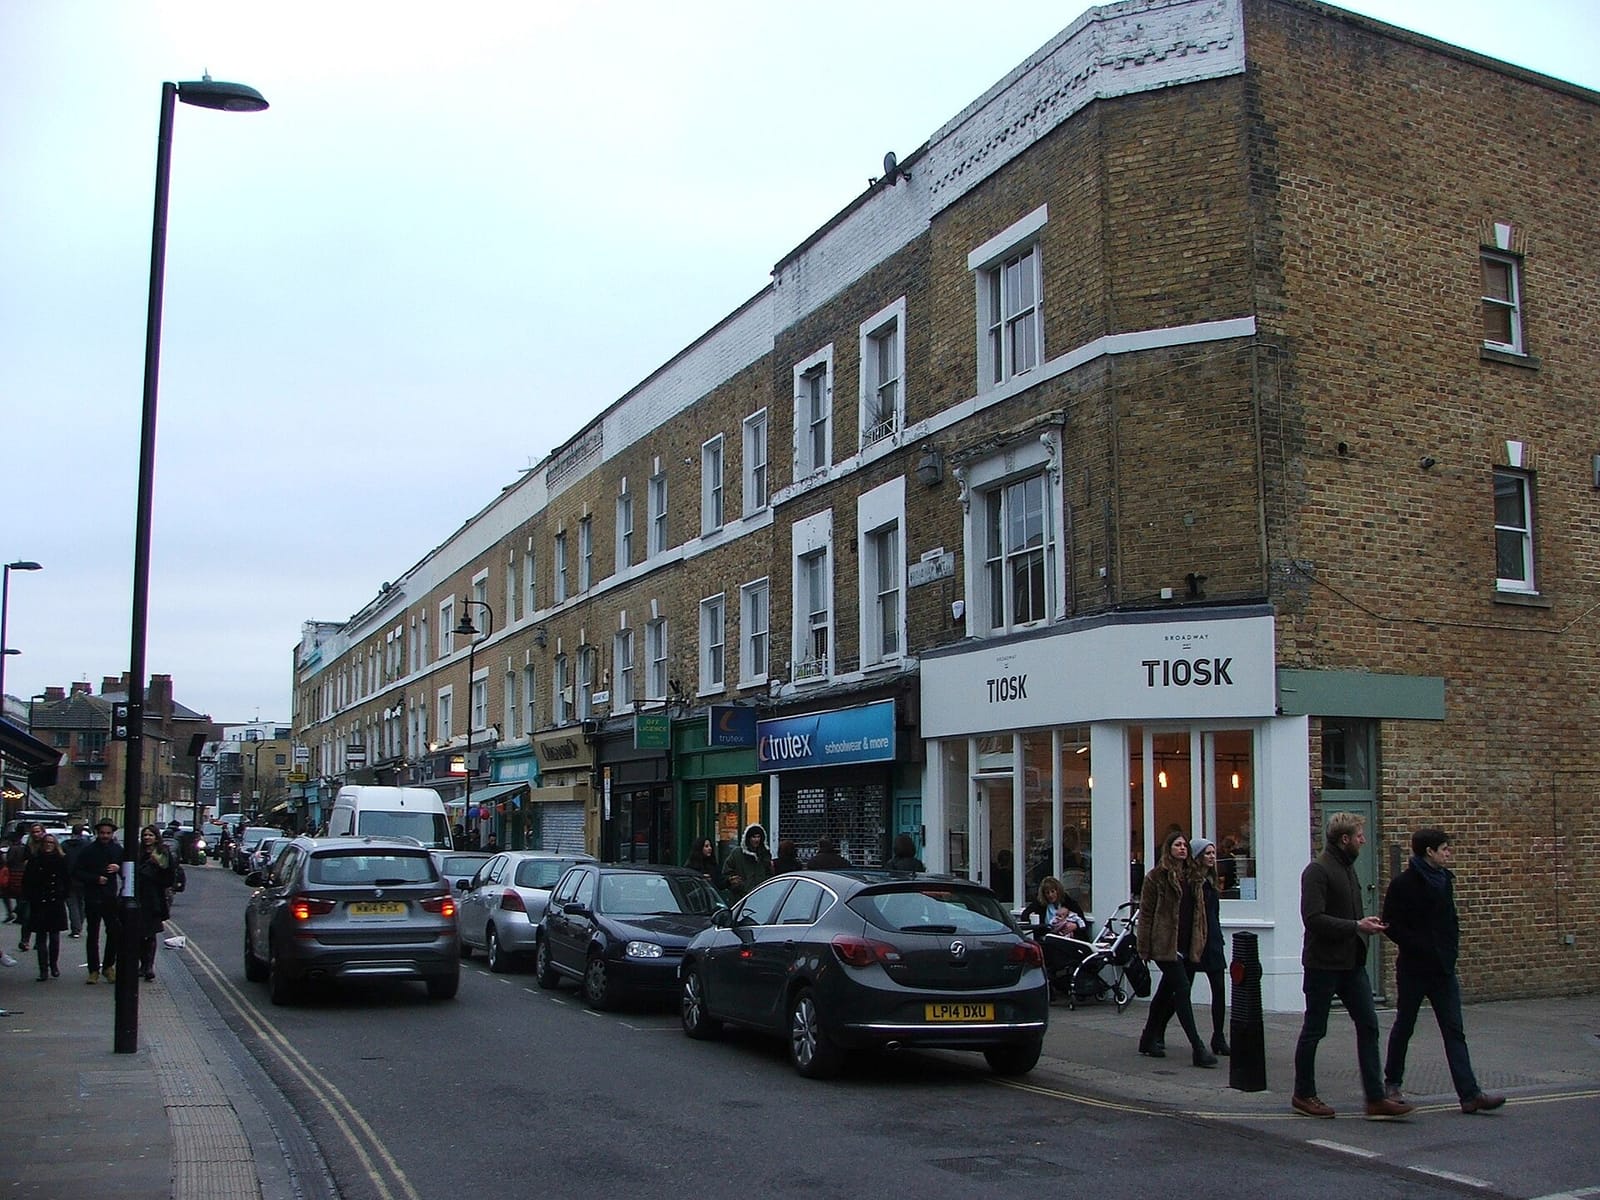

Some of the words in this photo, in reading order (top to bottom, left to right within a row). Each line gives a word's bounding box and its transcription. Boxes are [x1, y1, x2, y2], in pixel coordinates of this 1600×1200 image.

[1142, 657, 1233, 687] TIOSK
[986, 673, 1028, 703] TIOSK
[719, 735, 744, 743] trutex
[768, 732, 813, 761] trutex
[824, 741, 862, 755] schoolwear
[863, 736, 870, 750] &
[870, 736, 889, 749] more
[932, 1005, 960, 1019] LP14
[963, 1005, 987, 1019] DXU
